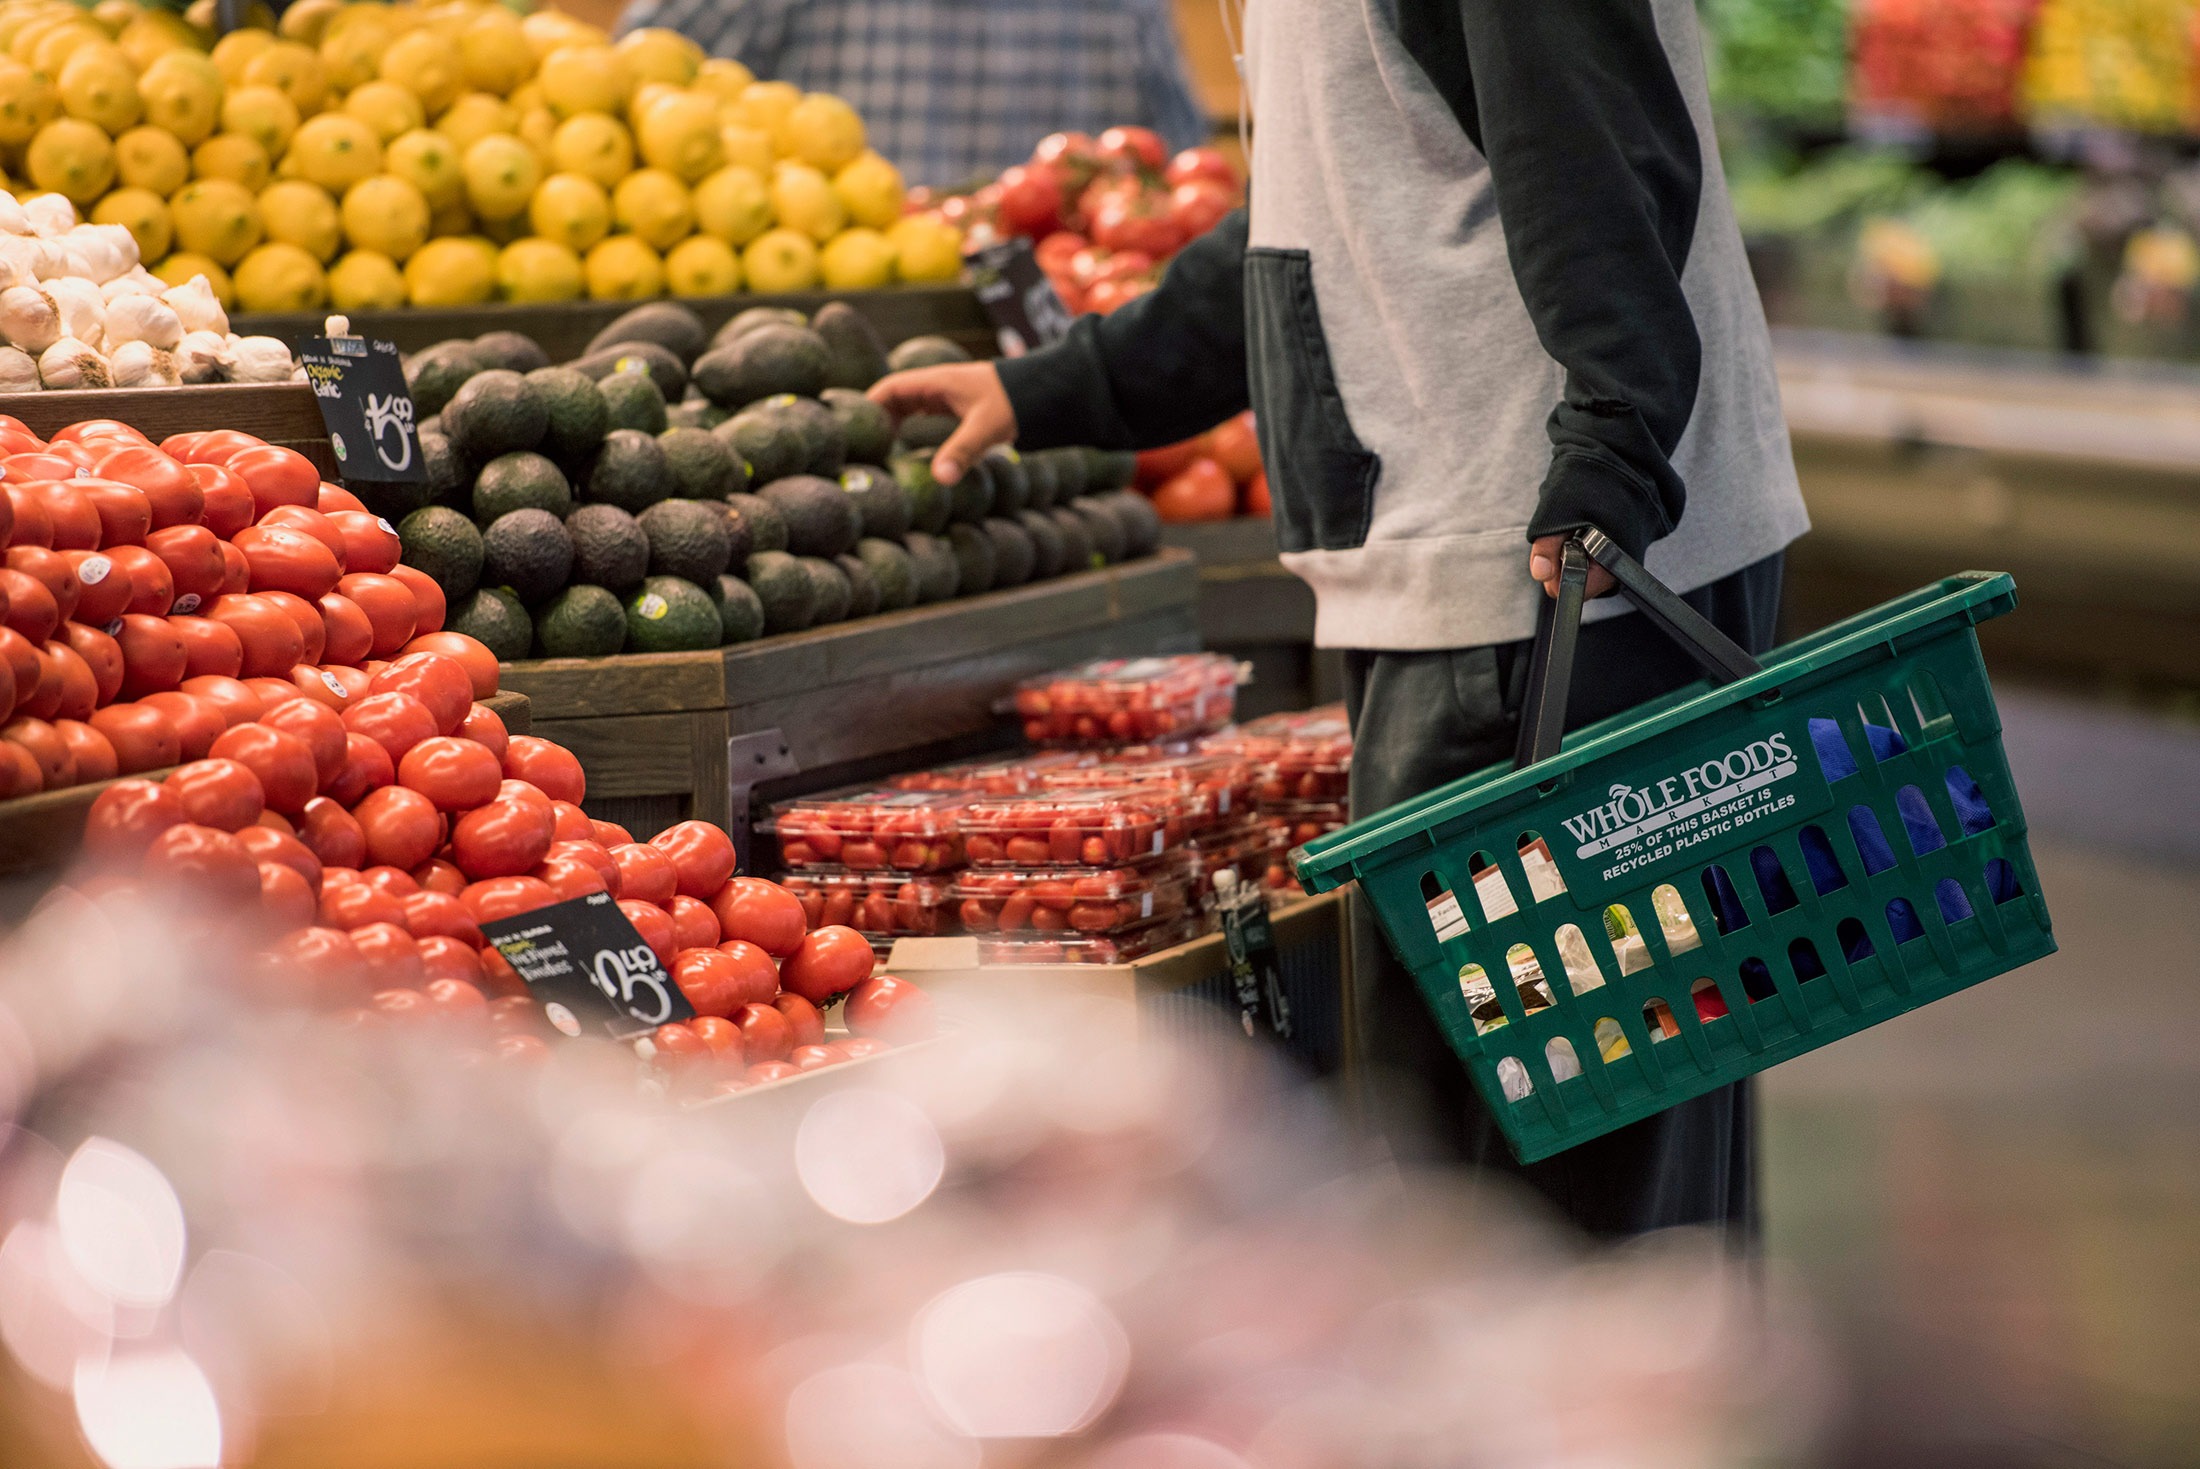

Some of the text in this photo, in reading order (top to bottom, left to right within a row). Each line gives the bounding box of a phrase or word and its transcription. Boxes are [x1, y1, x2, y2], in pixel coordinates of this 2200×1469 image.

[1561, 732, 1794, 843] WHOLE FOODS
[1599, 768, 1779, 850] MARKET
[1615, 788, 1772, 860] 25% OF THIS BASKET IS
[1602, 794, 1796, 881] RECYCLED PLASTIC BOTTLES
